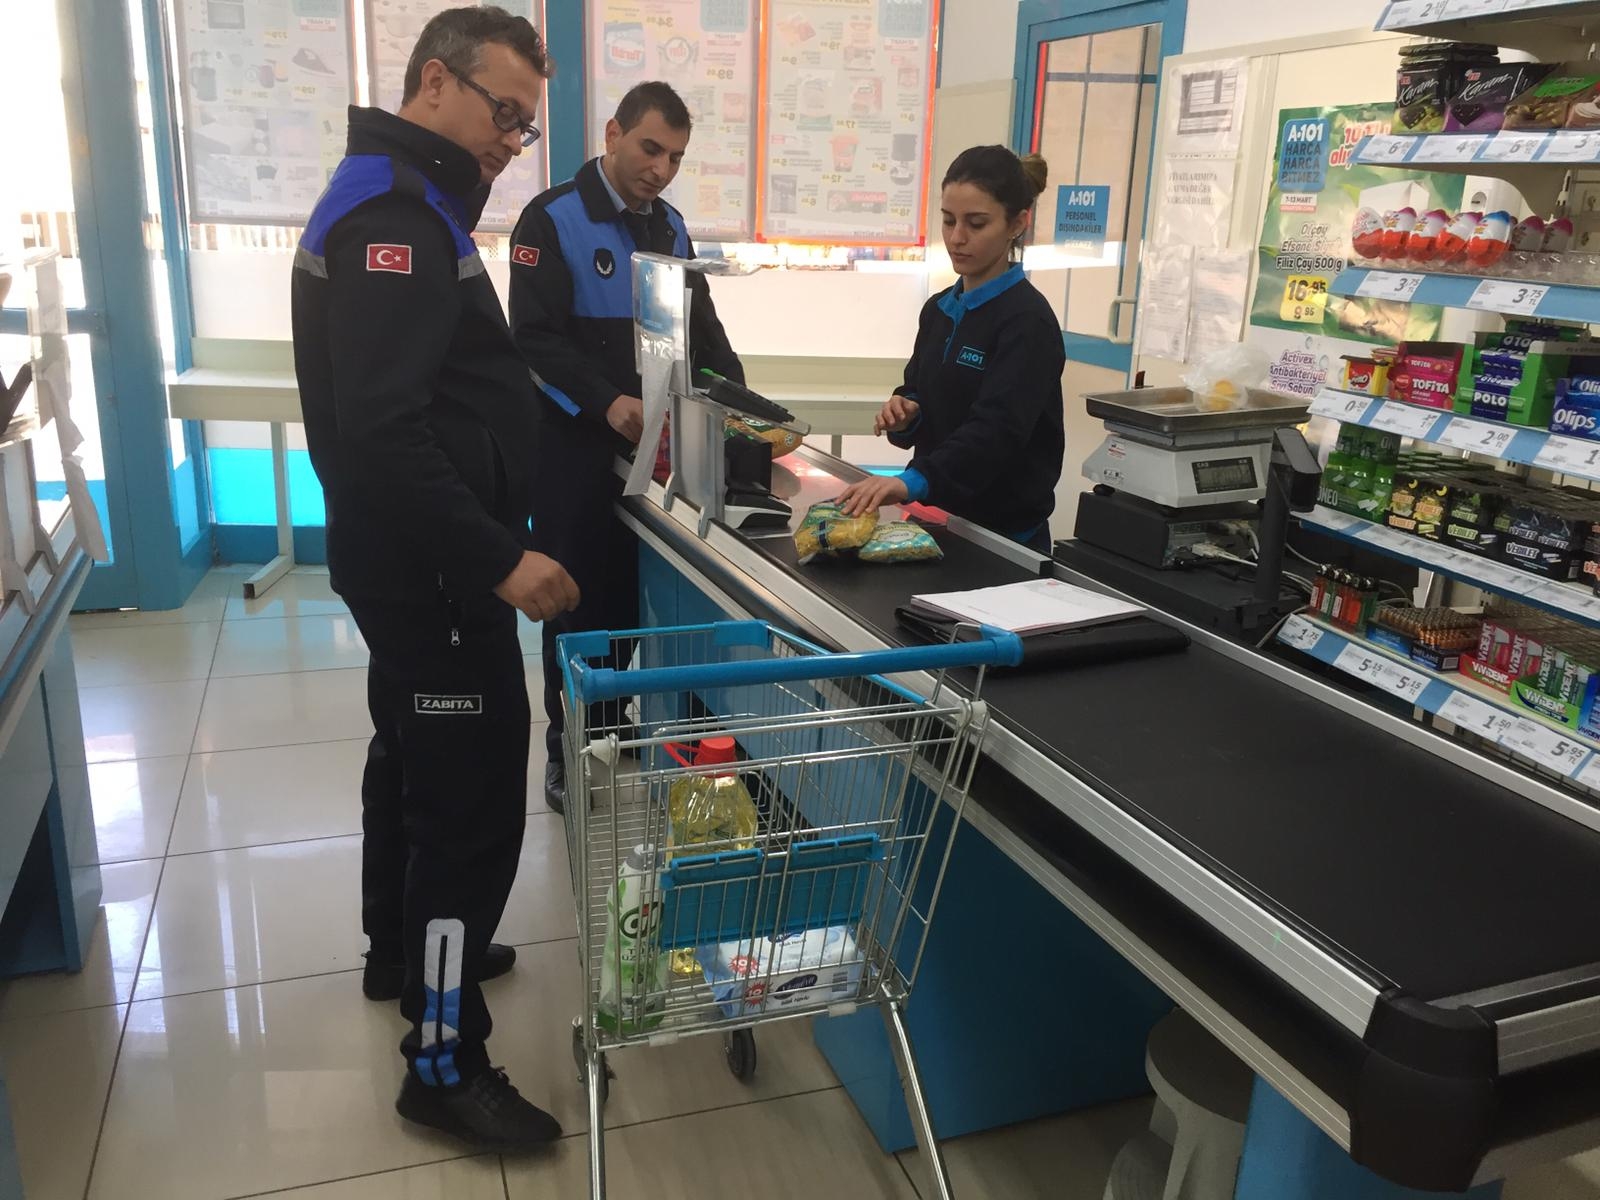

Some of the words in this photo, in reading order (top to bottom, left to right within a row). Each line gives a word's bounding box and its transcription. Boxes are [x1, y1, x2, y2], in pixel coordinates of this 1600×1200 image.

[1277, 257, 1294, 268] Filiz
[1315, 257, 1334, 269] 500
[1282, 352, 1313, 364] Activex
[1289, 382, 1314, 395] Sabun
[1473, 391, 1508, 407] POLO
[1554, 408, 1597, 430] Olips
[421, 699, 474, 709] ZABITA
